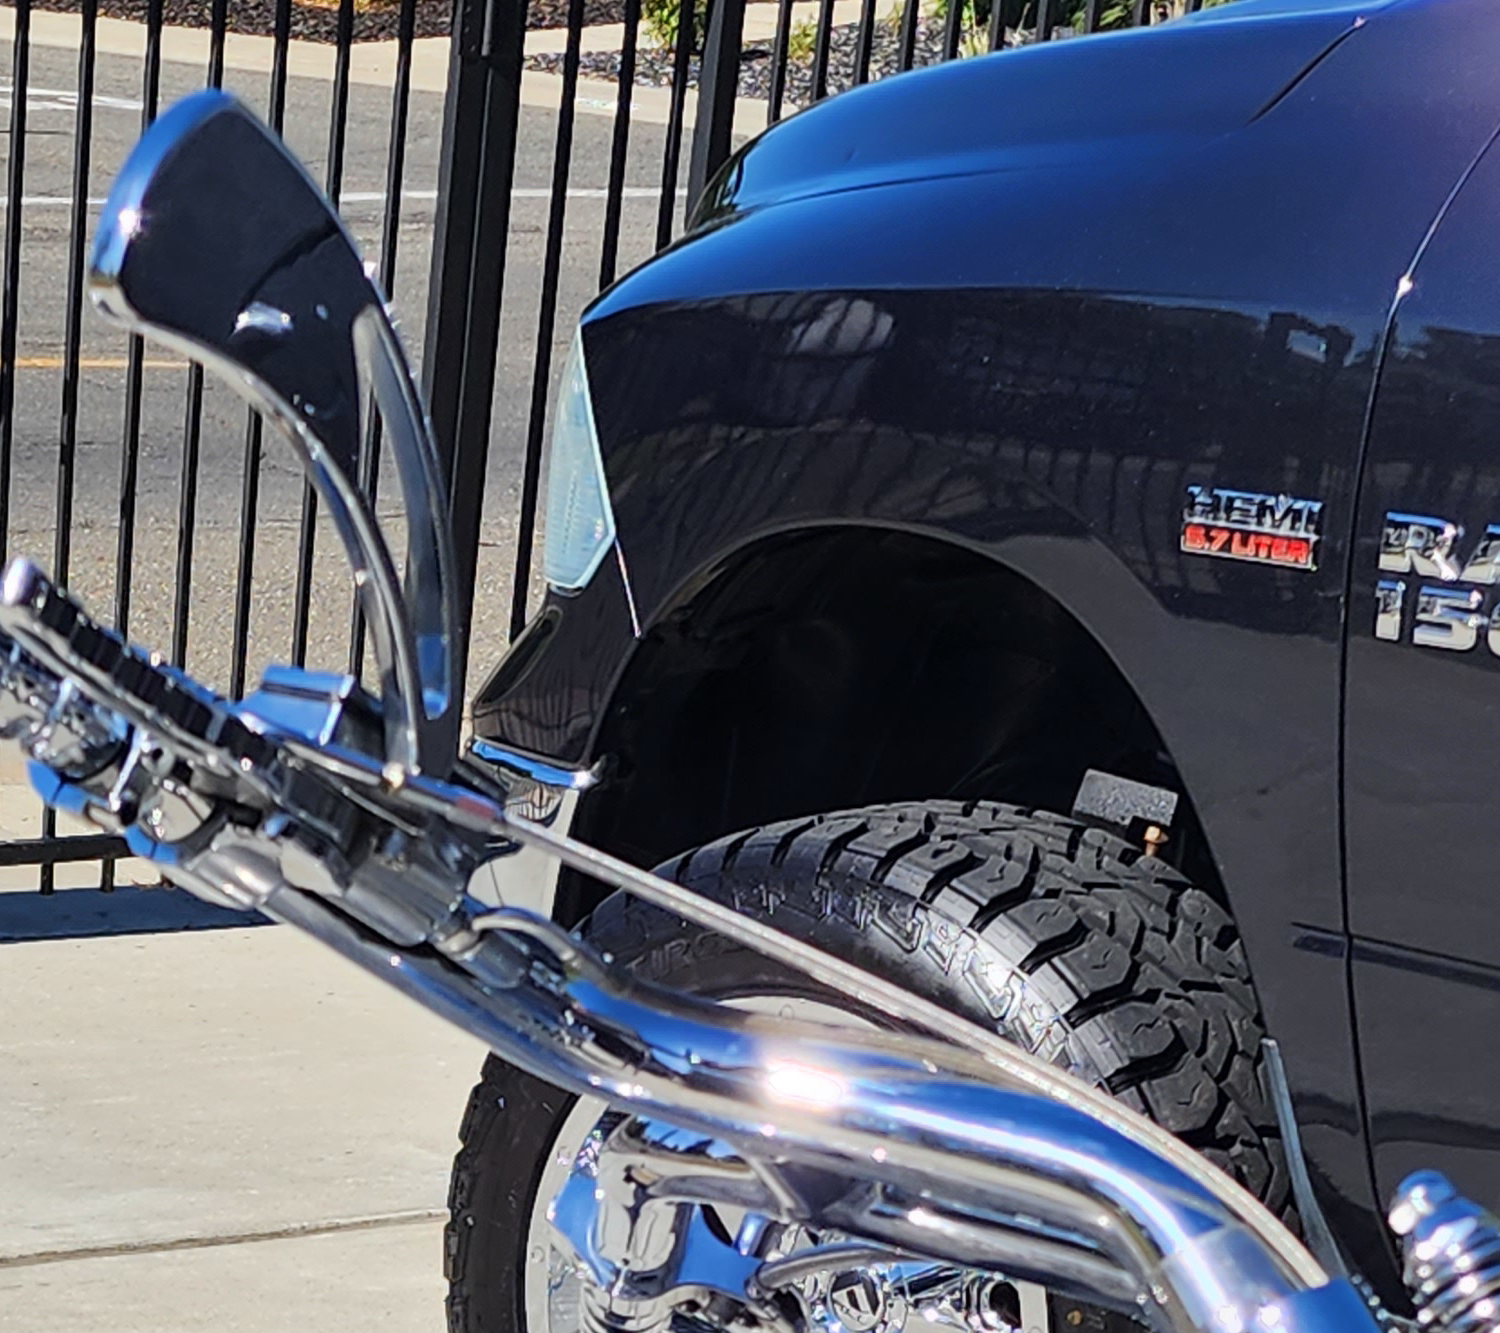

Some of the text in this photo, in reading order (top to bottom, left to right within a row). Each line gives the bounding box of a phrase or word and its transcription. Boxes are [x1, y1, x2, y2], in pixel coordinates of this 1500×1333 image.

[1184, 485, 1323, 532] HEMI
[1186, 524, 1310, 564] 5.7 LITER
[1375, 579, 1500, 656] 15
